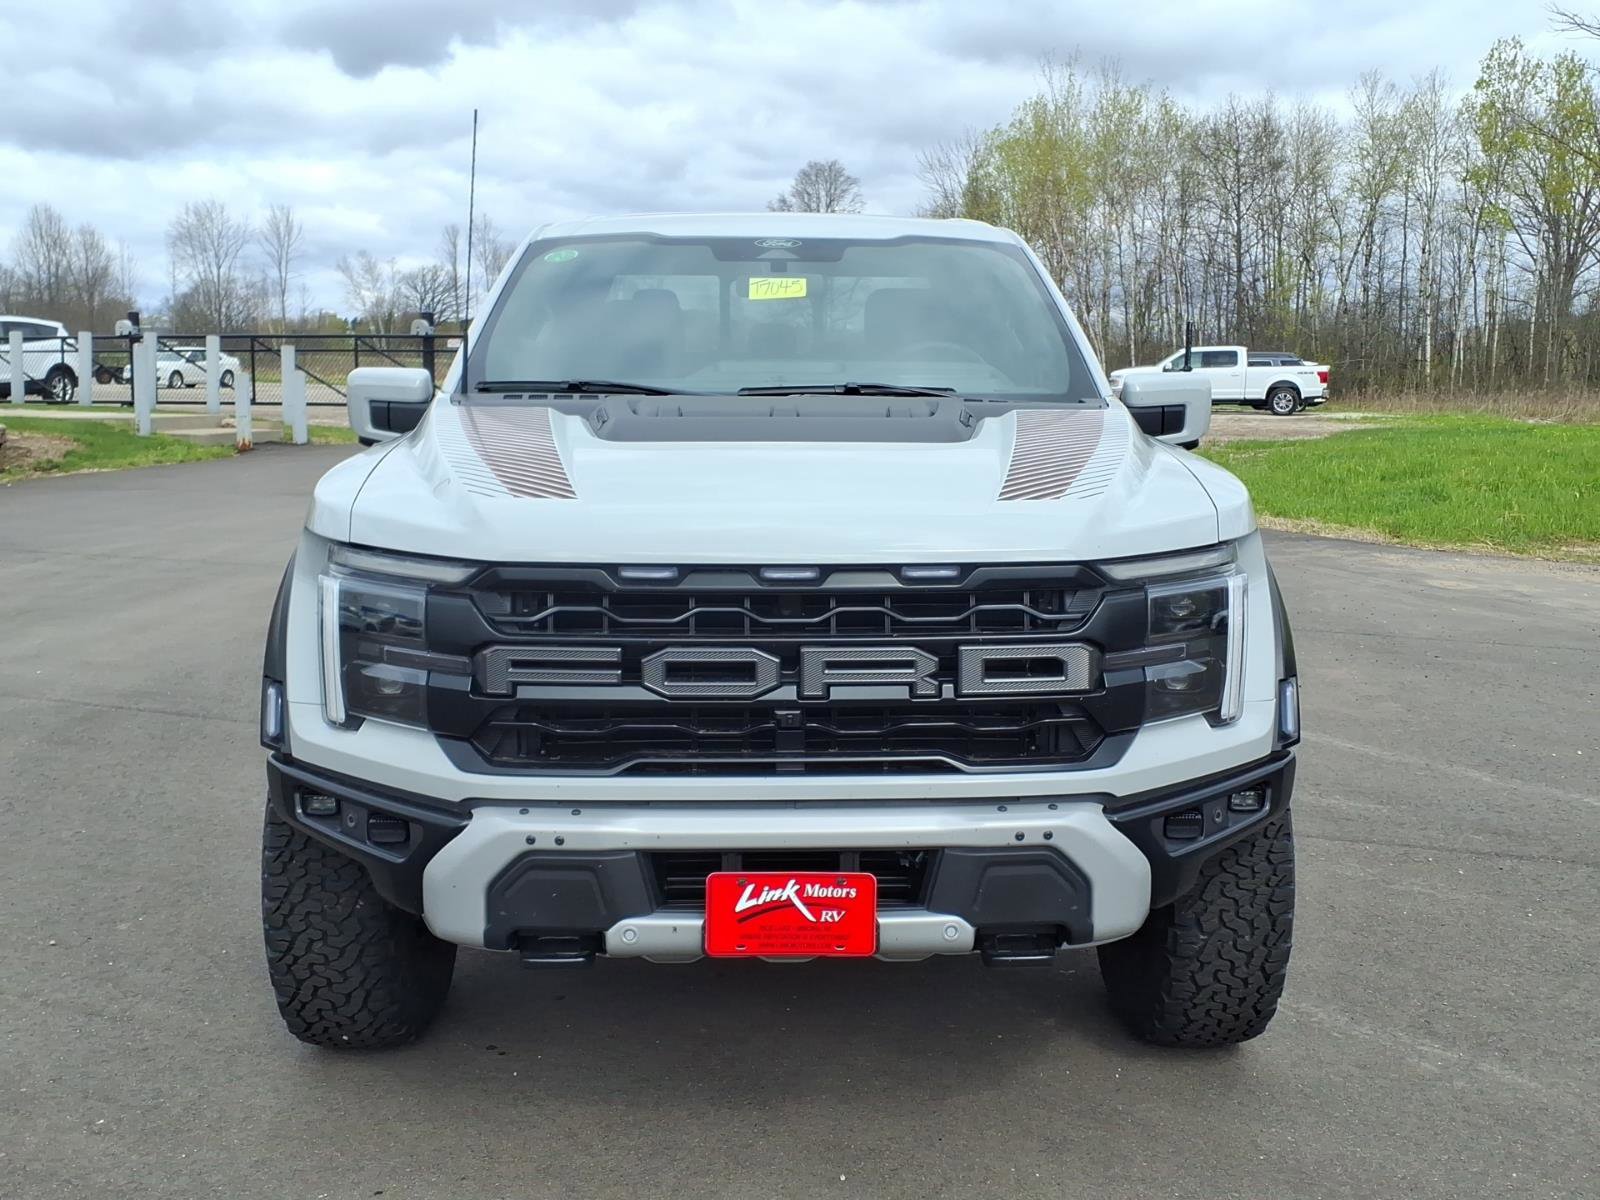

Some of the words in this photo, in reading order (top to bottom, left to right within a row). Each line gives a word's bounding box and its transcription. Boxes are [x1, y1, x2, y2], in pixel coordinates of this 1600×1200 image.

[751, 279, 803, 296] T7045
[477, 644, 1099, 701] FORD
[734, 879, 817, 922] Link
[803, 883, 857, 898] Motors
[820, 910, 846, 923] RV
